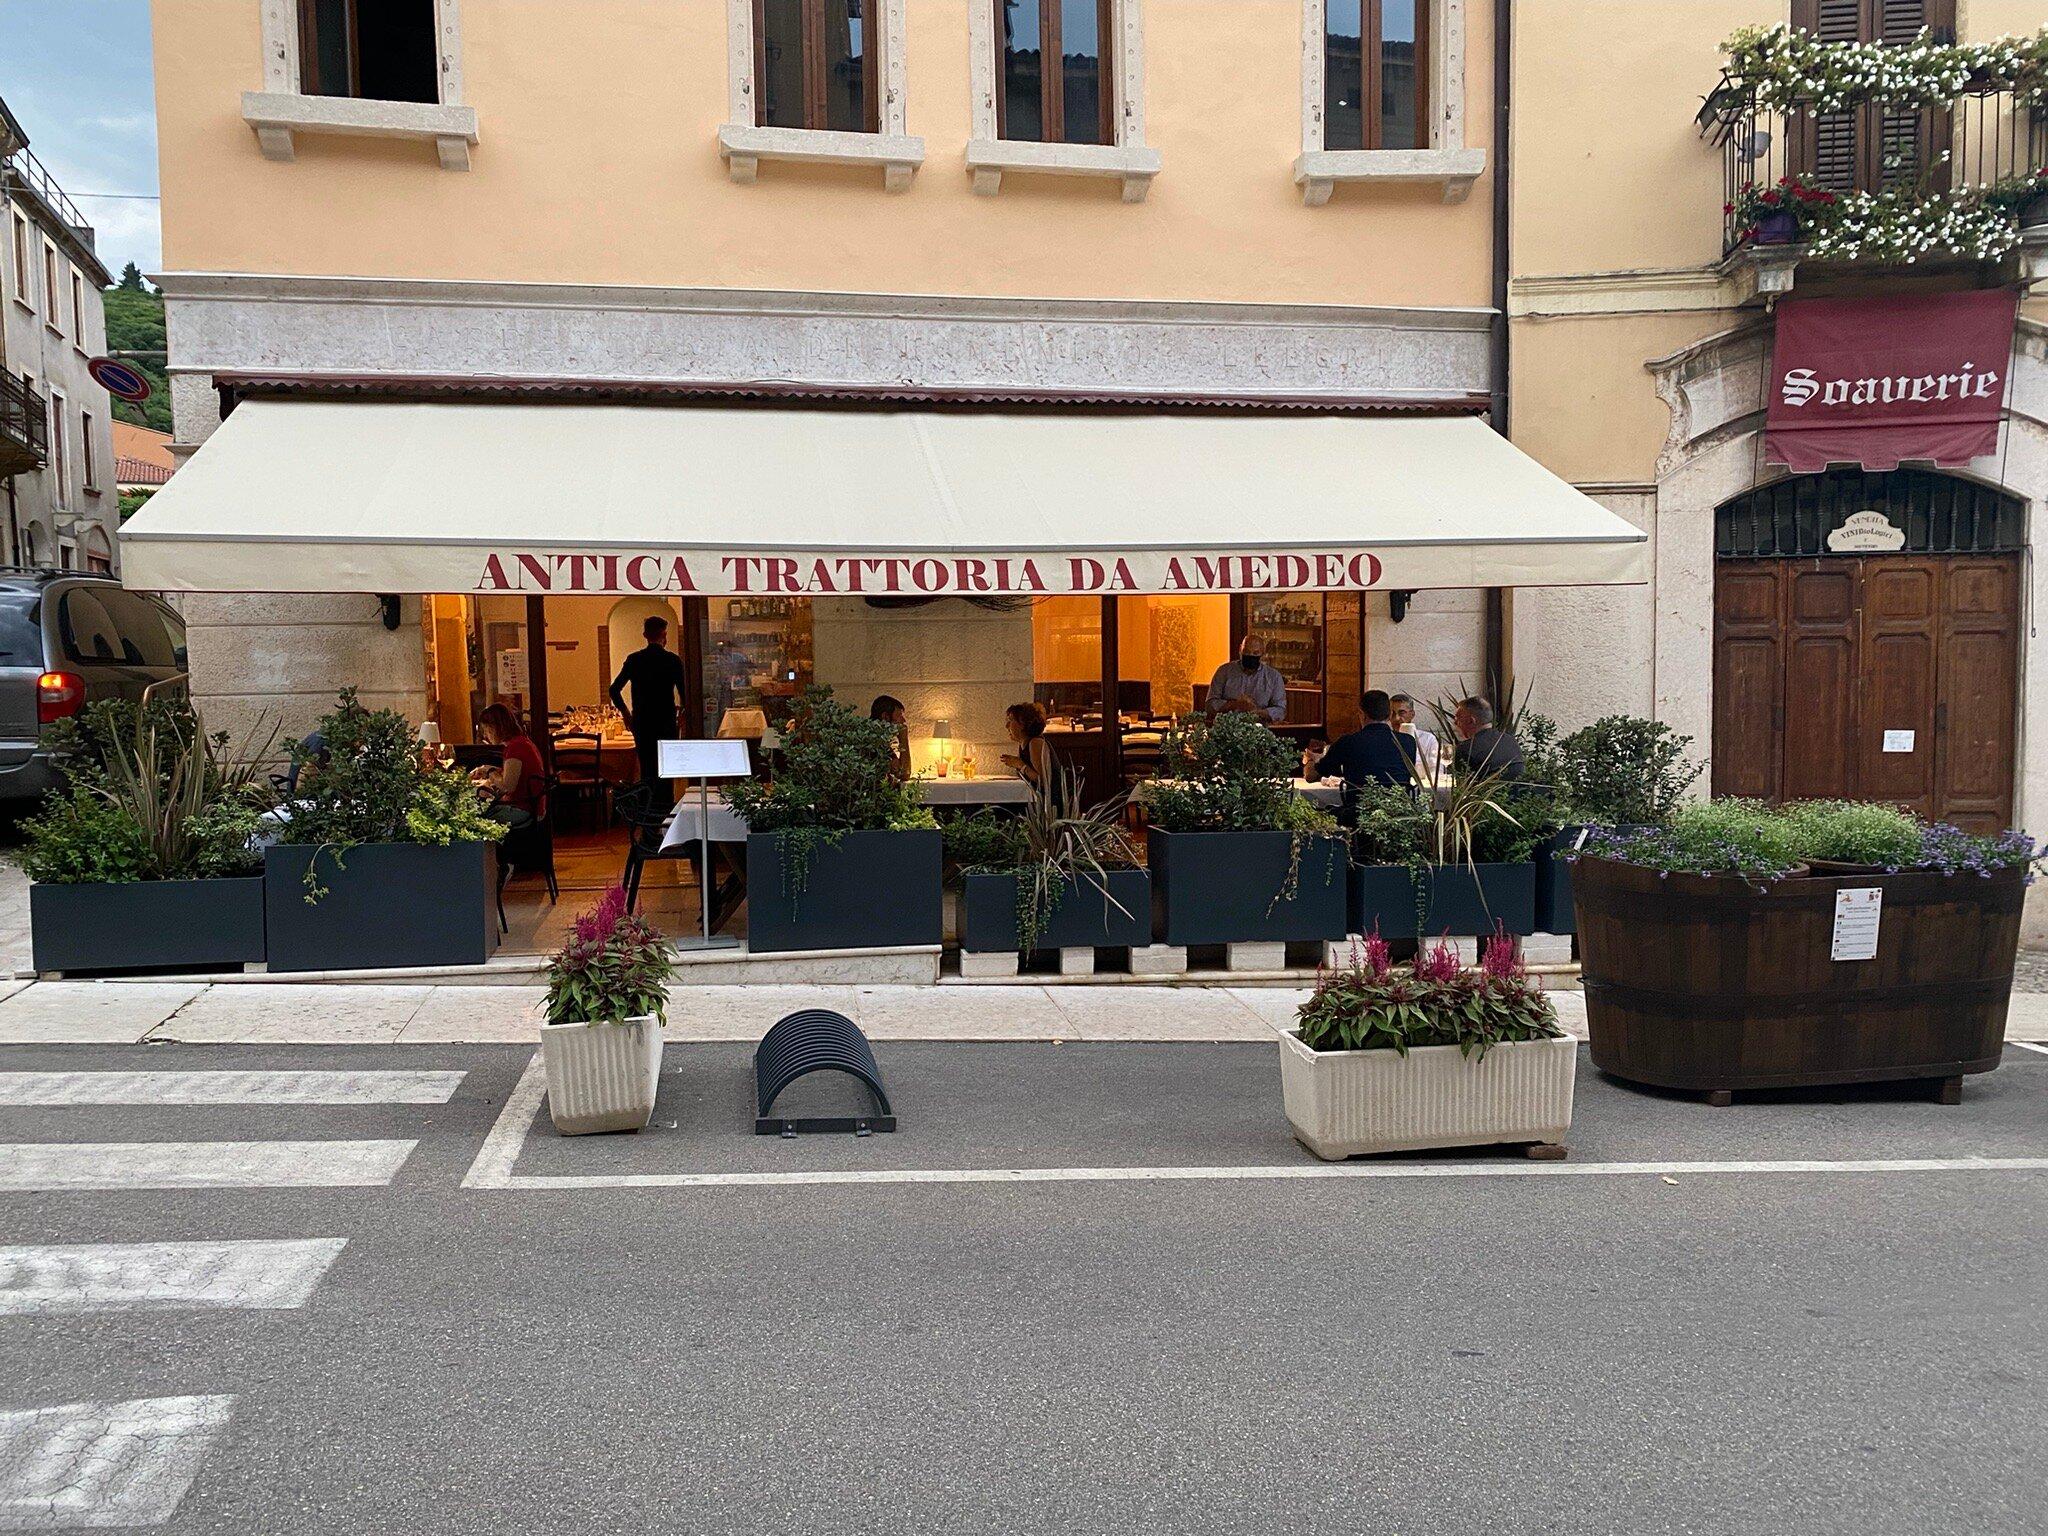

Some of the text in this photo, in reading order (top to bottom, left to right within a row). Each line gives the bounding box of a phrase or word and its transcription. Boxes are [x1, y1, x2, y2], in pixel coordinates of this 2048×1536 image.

[1781, 361, 1999, 407] Soaverie
[472, 552, 1382, 593] ANTICA TRATTORIA DA AMEDEO
